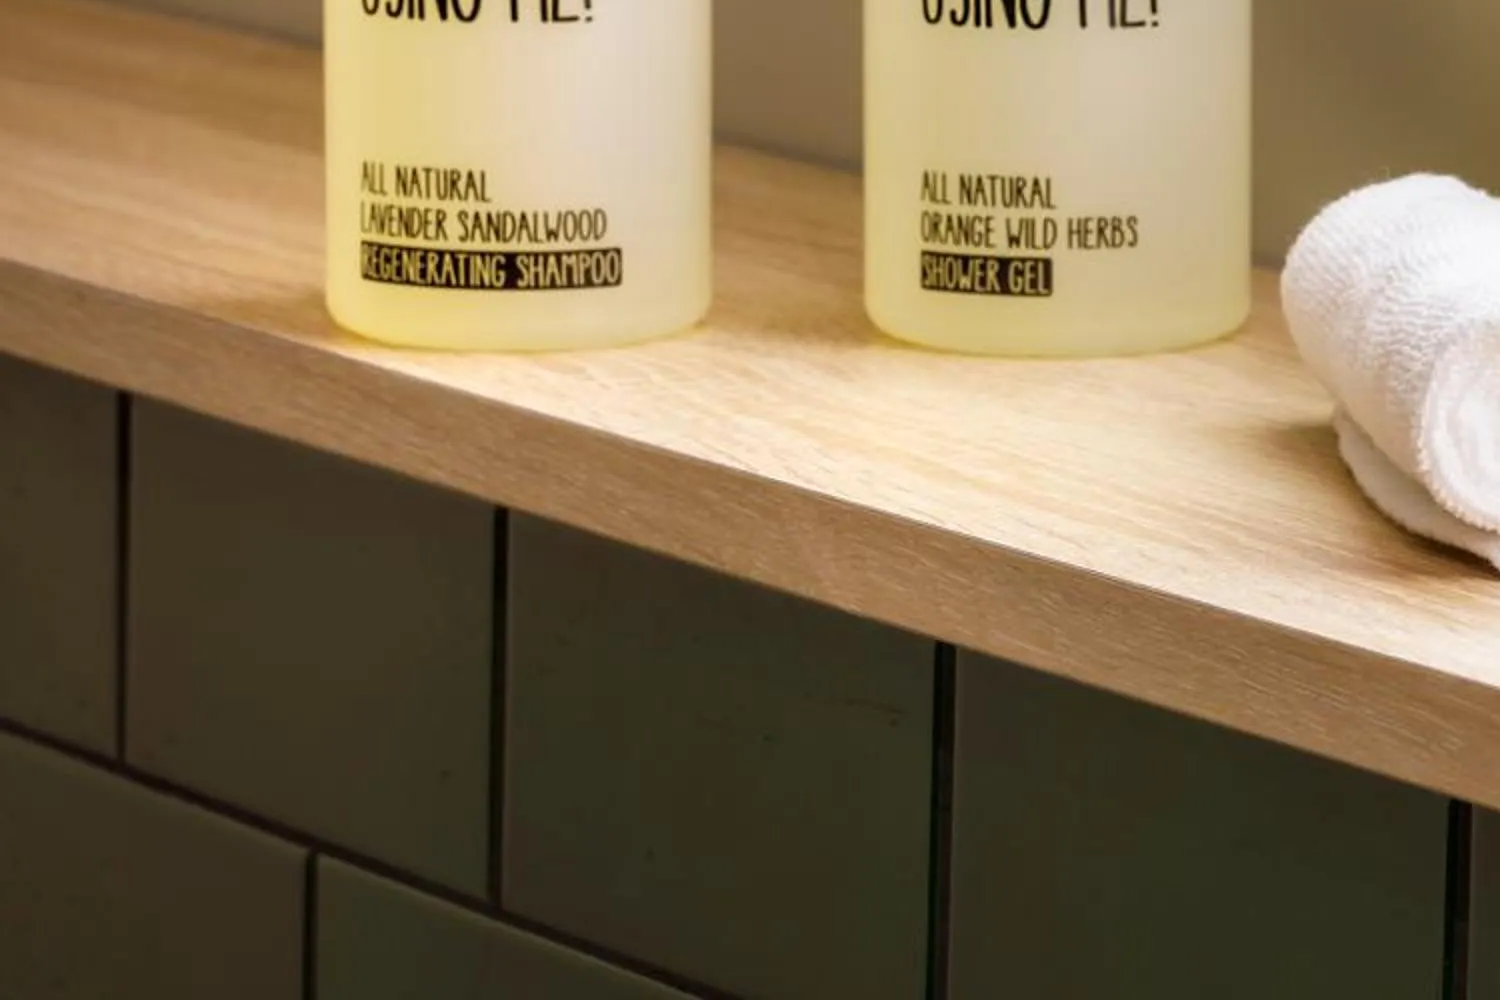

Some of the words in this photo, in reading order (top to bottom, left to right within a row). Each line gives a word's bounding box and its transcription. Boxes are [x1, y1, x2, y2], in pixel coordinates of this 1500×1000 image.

[361, 160, 388, 195] ALL
[395, 165, 492, 203] NATURAL
[921, 170, 952, 204] ALL
[959, 174, 1056, 209] NATURAL
[361, 202, 449, 241] LAVENDER
[457, 208, 608, 243] SANDALWOOD
[921, 210, 996, 248] ORANGE
[1005, 217, 1057, 249] WILD
[1067, 215, 1139, 250] HERBS
[362, 244, 506, 287] REGENERATING
[515, 250, 620, 287] SHAMPOO
[922, 253, 1000, 292] SHOWER
[1008, 261, 1050, 295] GEL
